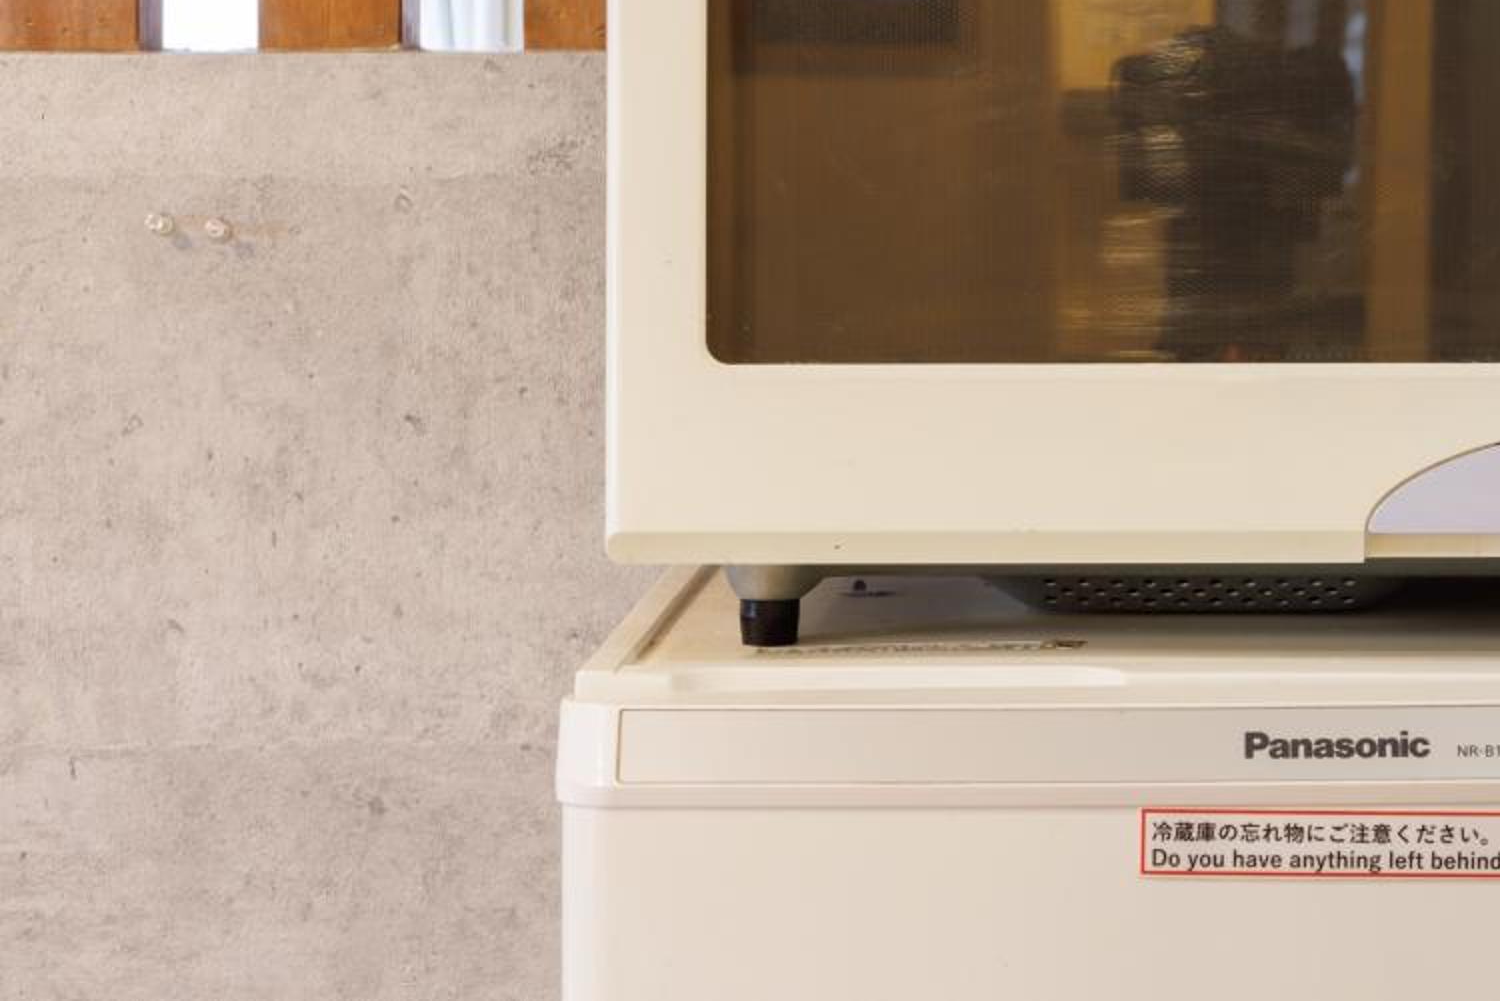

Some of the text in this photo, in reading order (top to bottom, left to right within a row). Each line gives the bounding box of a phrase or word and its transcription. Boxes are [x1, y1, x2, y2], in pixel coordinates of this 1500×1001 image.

[1244, 731, 1431, 760] Panasonic
[1152, 821, 1489, 846] 冷蔵庫の忘れ物にご注意ください。
[1152, 848, 1181, 868] Do
[1187, 852, 1225, 872] you
[1233, 849, 1282, 868] have
[1289, 849, 1382, 874] anything
[1388, 850, 1424, 870] left
